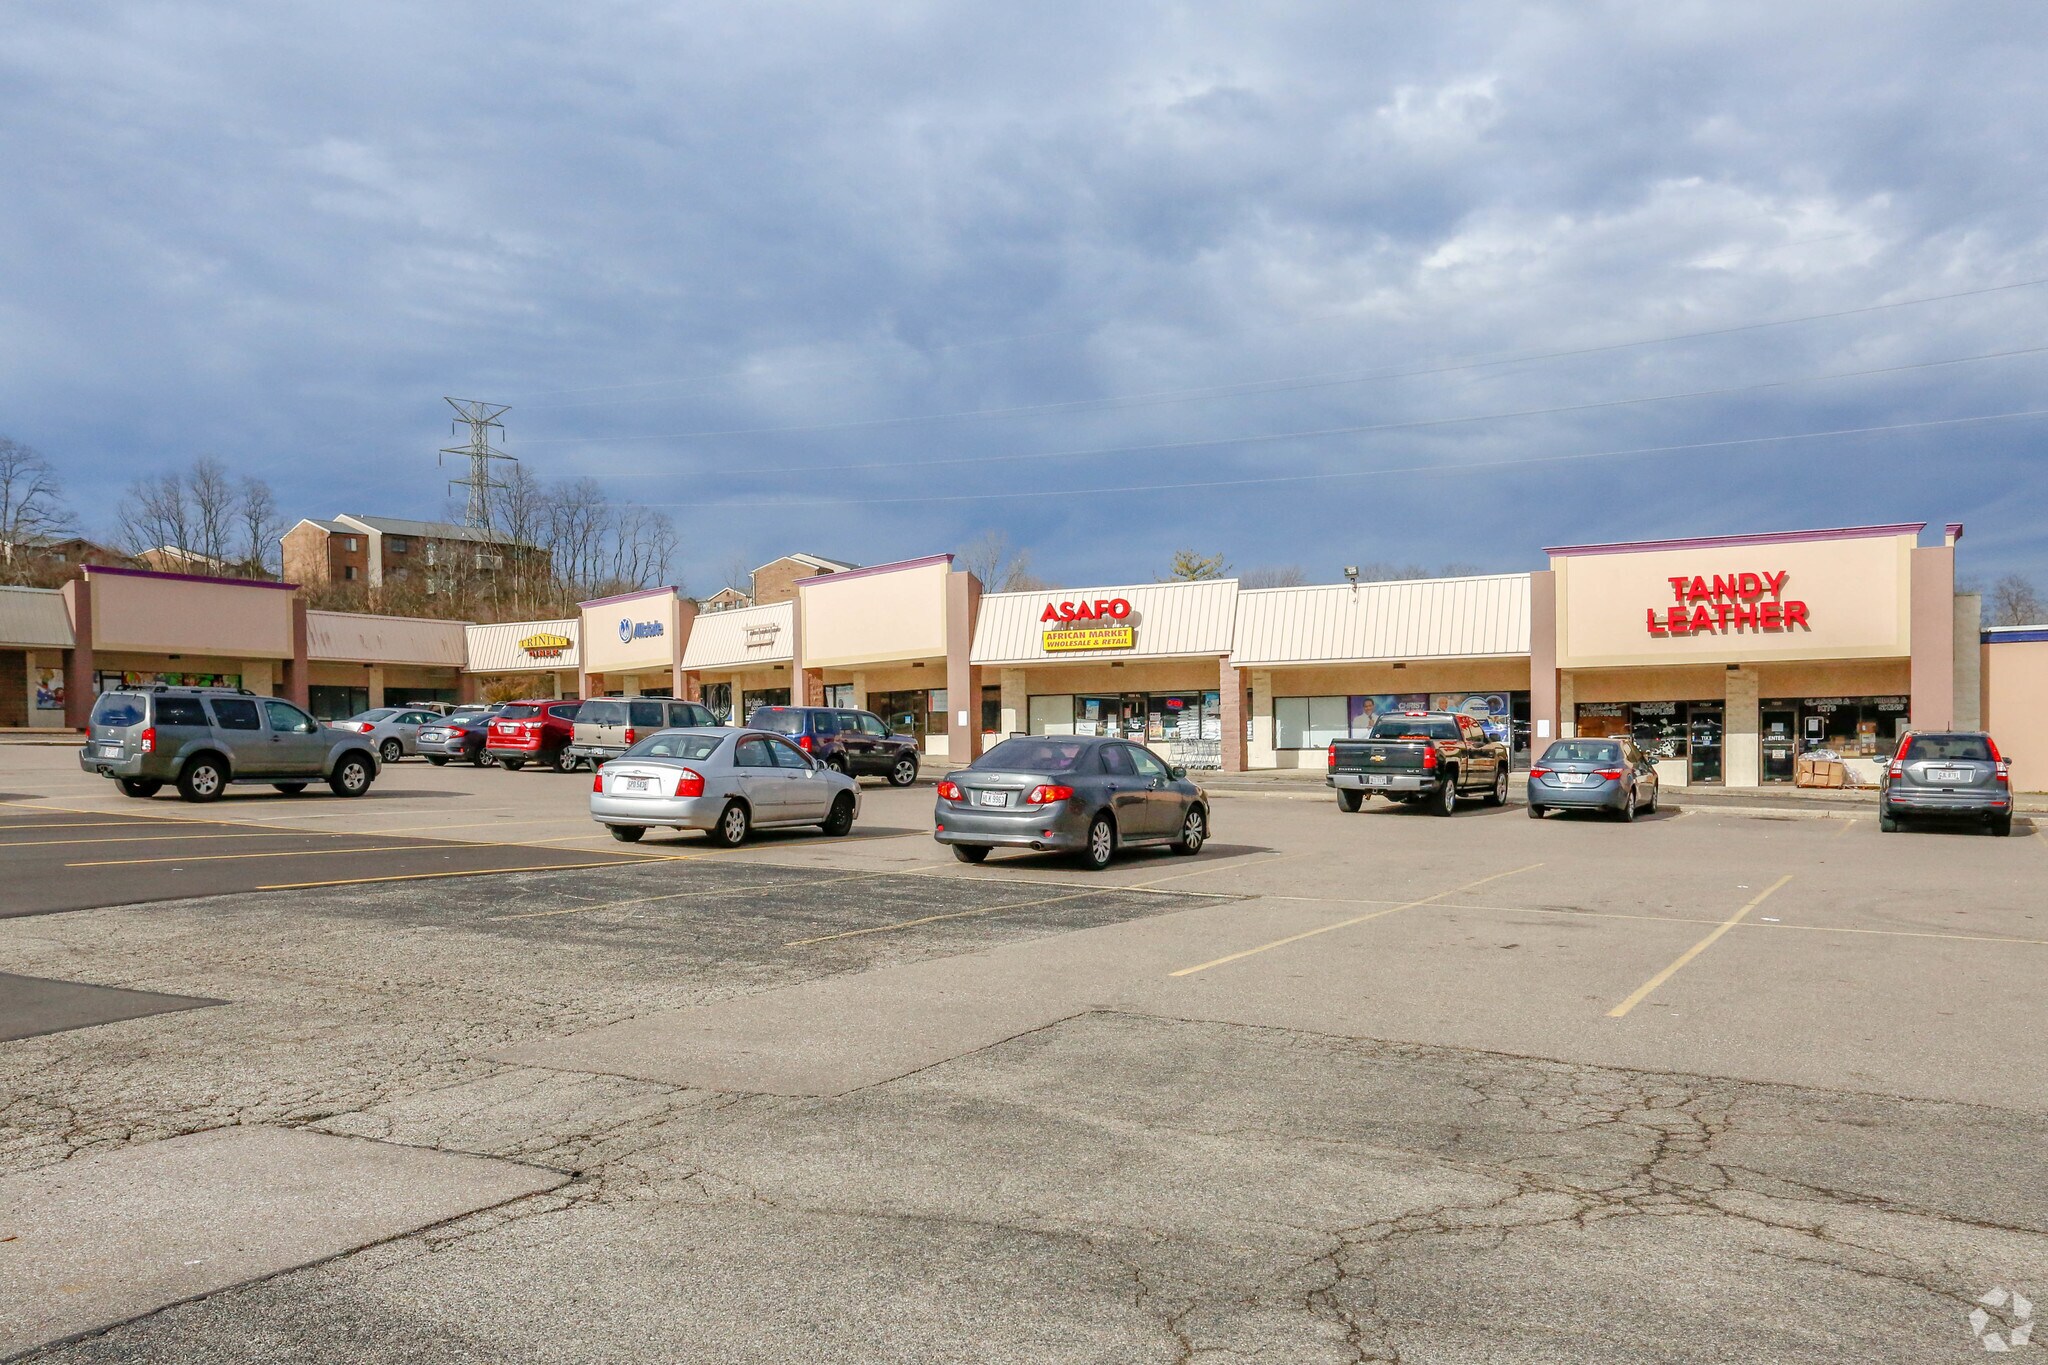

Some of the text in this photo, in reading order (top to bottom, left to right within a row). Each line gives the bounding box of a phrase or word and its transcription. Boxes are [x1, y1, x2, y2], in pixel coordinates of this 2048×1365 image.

[1668, 571, 1786, 602] TANDY
[1040, 598, 1131, 622] ASAFO
[1647, 601, 1810, 632] LEATHER
[633, 620, 664, 638] Allstate
[1046, 629, 1128, 641] AFRICAN MARKET
[520, 635, 566, 648] TRINITY
[1047, 640, 1091, 648] WHOLESALE
[1101, 637, 1128, 645] RETAIL
[528, 649, 559, 658] DINER
[1166, 699, 1185, 708] OPEN
[1398, 701, 1426, 710] CHRIST
